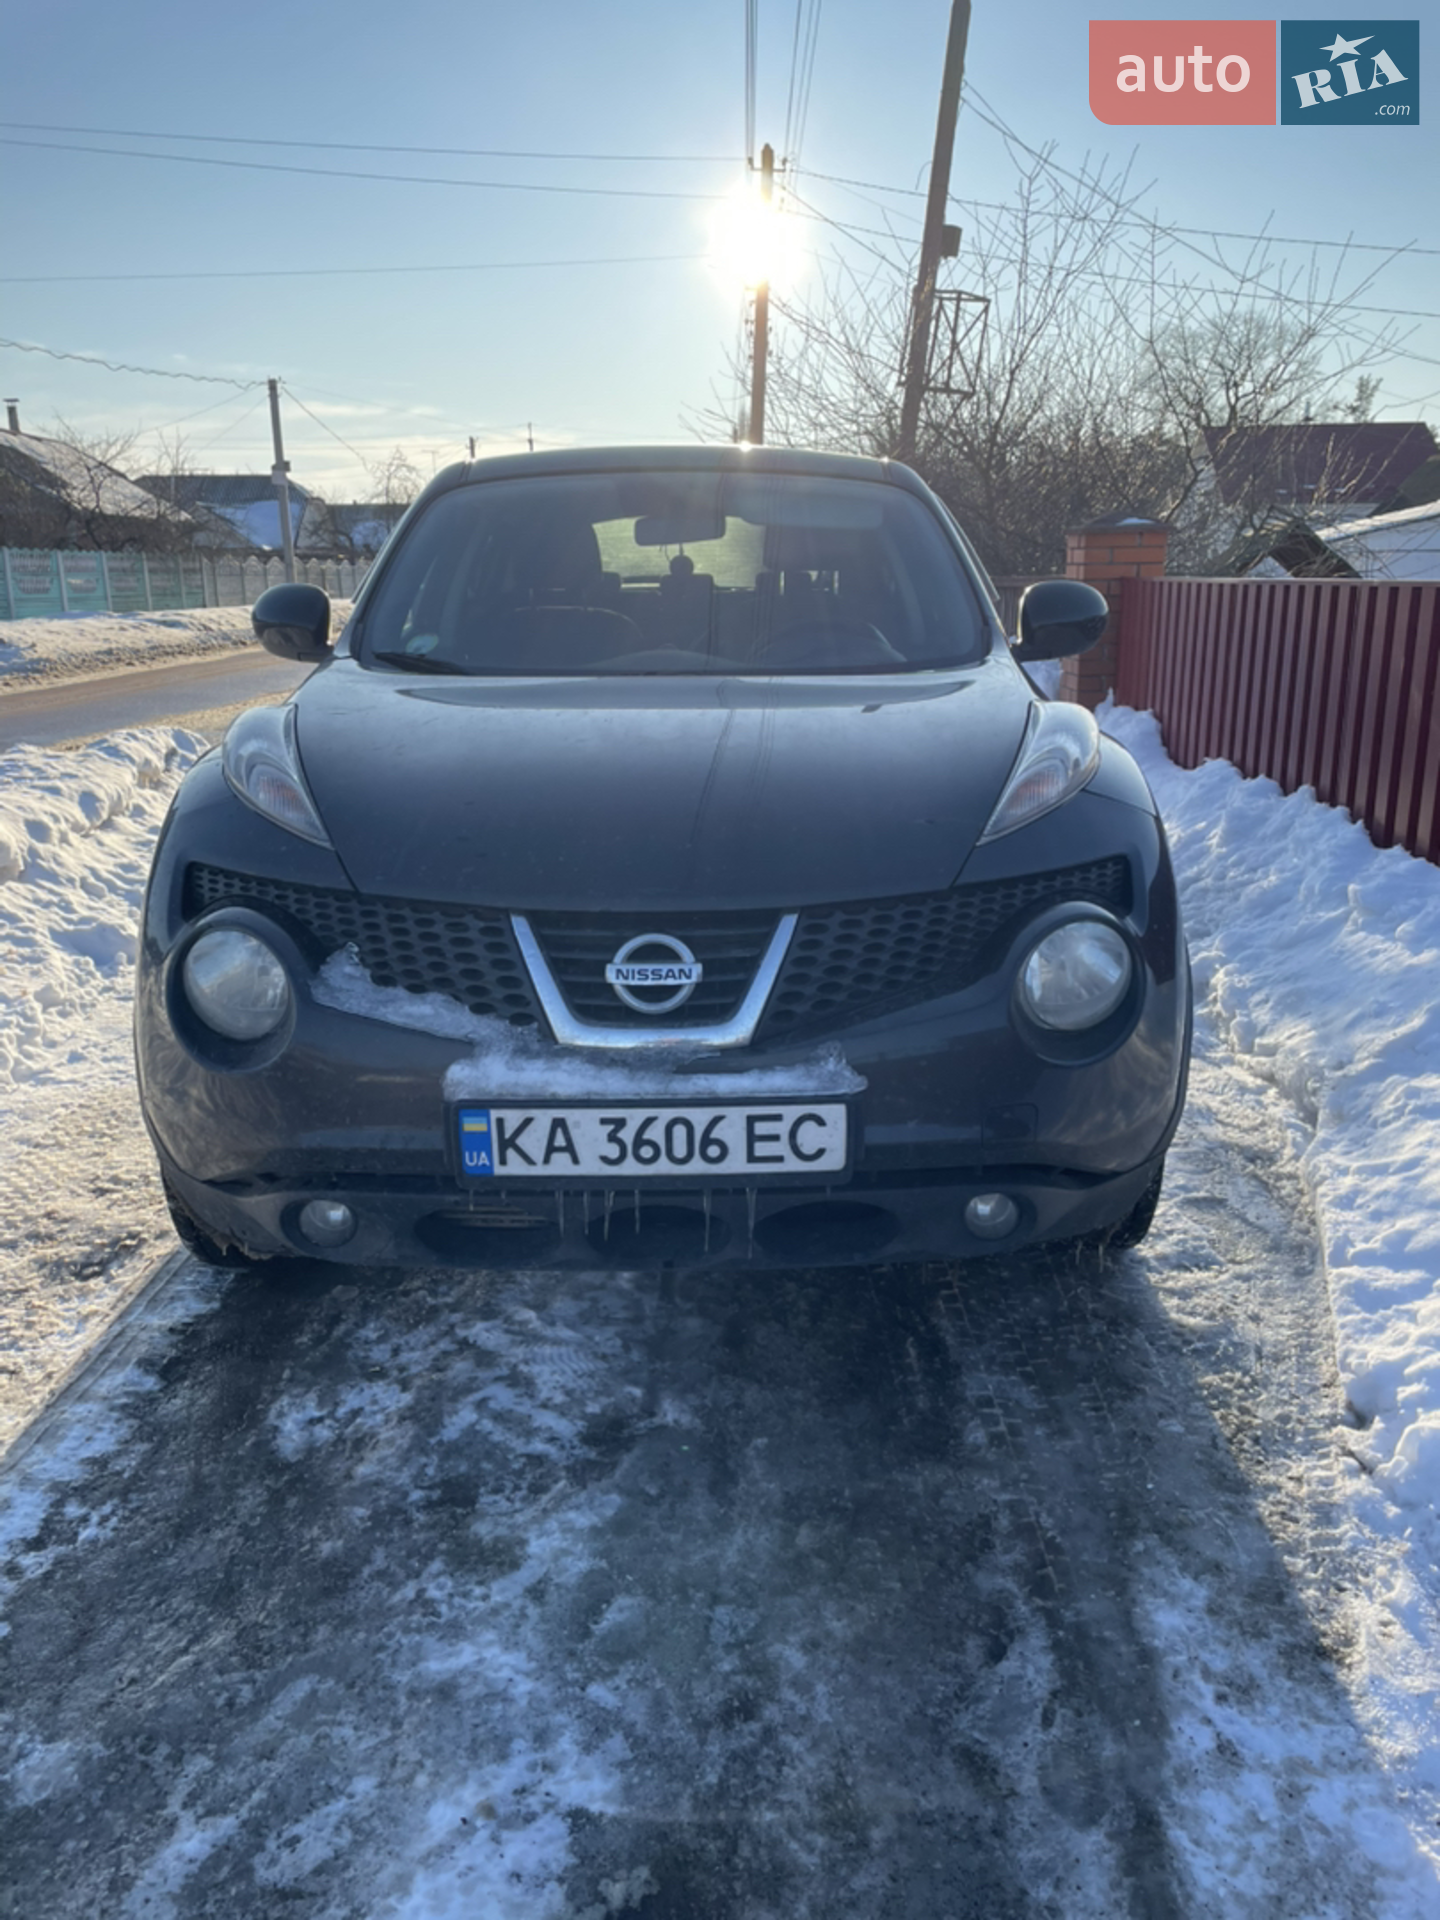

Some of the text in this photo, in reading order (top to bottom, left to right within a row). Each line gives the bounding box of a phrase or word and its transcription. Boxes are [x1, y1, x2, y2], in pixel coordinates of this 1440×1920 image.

[615, 968, 693, 981] NISSAN
[495, 1112, 828, 1167] KA 3606 EC
[465, 1151, 490, 1167] UA
